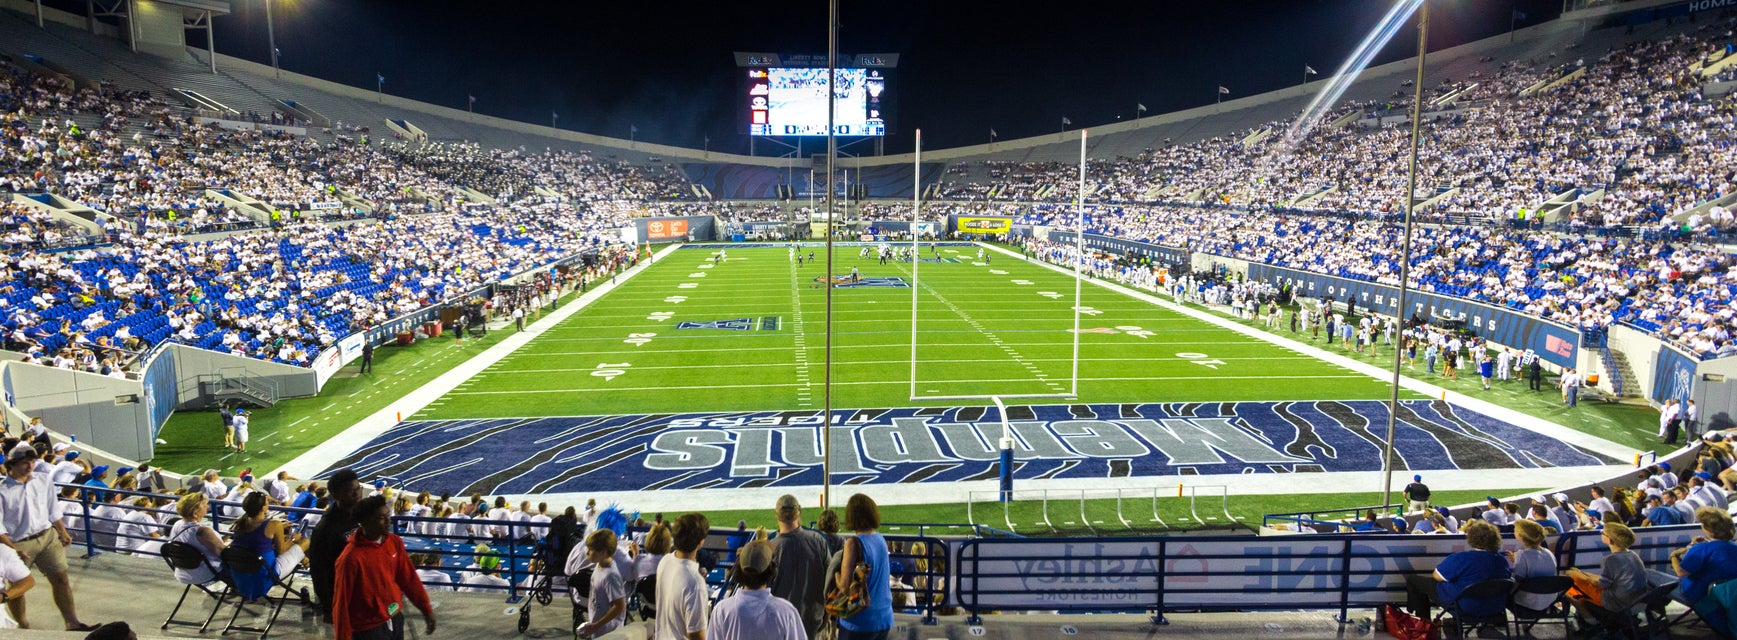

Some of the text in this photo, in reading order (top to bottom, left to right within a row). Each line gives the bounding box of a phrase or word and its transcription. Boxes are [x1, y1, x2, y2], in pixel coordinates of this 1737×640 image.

[1328, 285, 1347, 297] OF
[1362, 292, 1398, 308] THE
[1415, 302, 1496, 331] TIGERS
[1114, 325, 1157, 336] 20
[623, 332, 657, 344] 20
[1175, 352, 1227, 366] 10
[590, 362, 632, 377] 10
[667, 414, 881, 427] TIGERS
[643, 416, 1315, 477] Memphis
